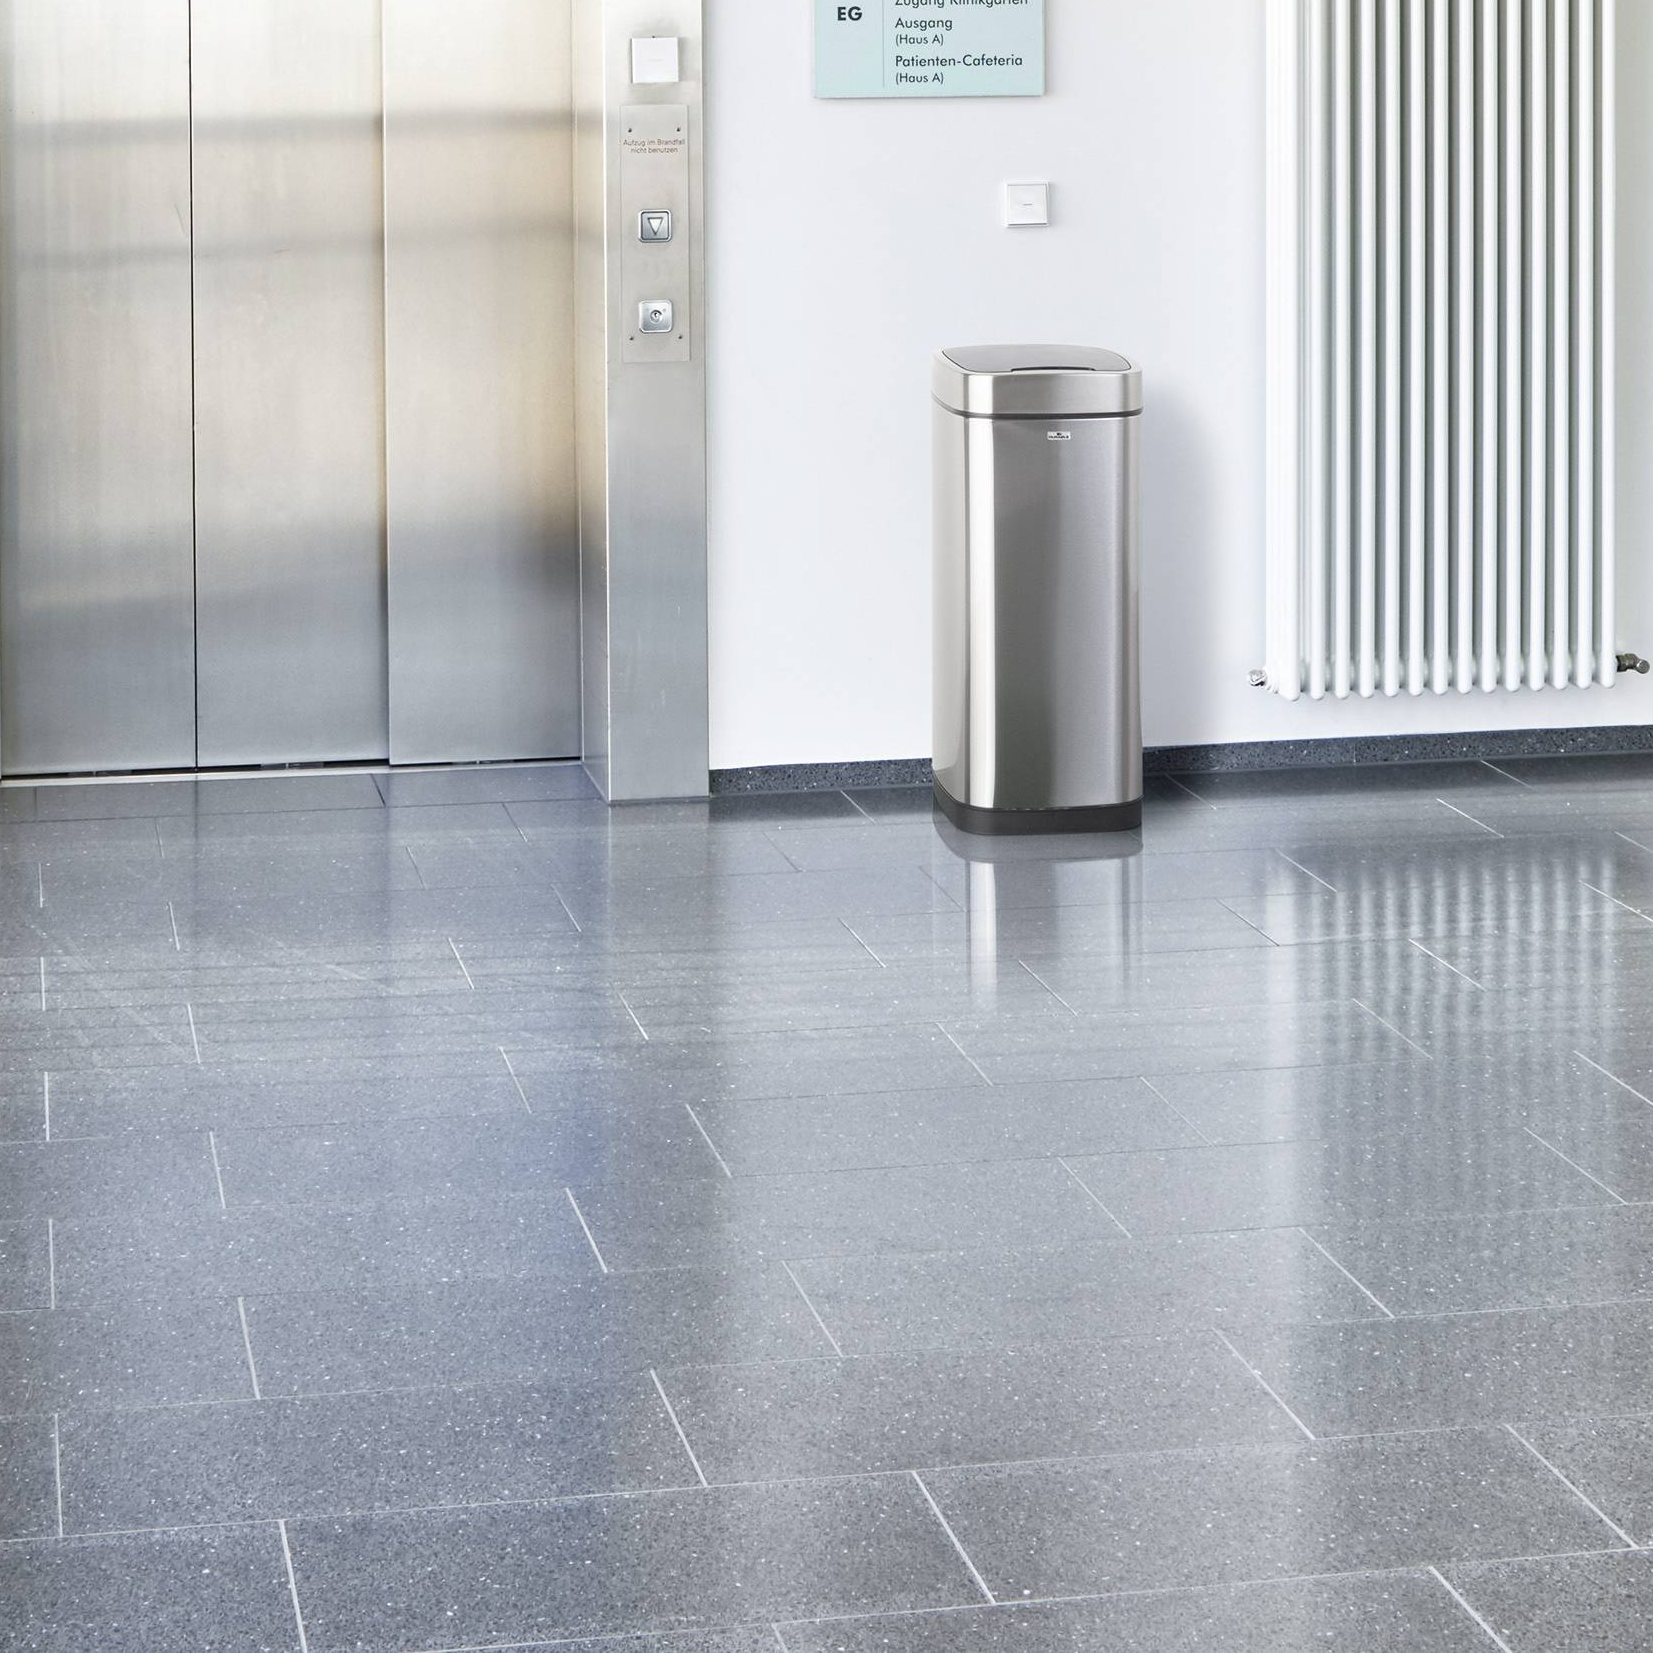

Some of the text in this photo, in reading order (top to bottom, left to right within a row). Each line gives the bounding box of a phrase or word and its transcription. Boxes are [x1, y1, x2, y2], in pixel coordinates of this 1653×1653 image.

[837, 6, 863, 21] EG
[895, 17, 953, 31] Ausgang
[895, 33, 944, 47] (Haus A)
[895, 54, 1023, 67] Patienten-Cafeteria
[895, 72, 944, 85] (Haus A)
